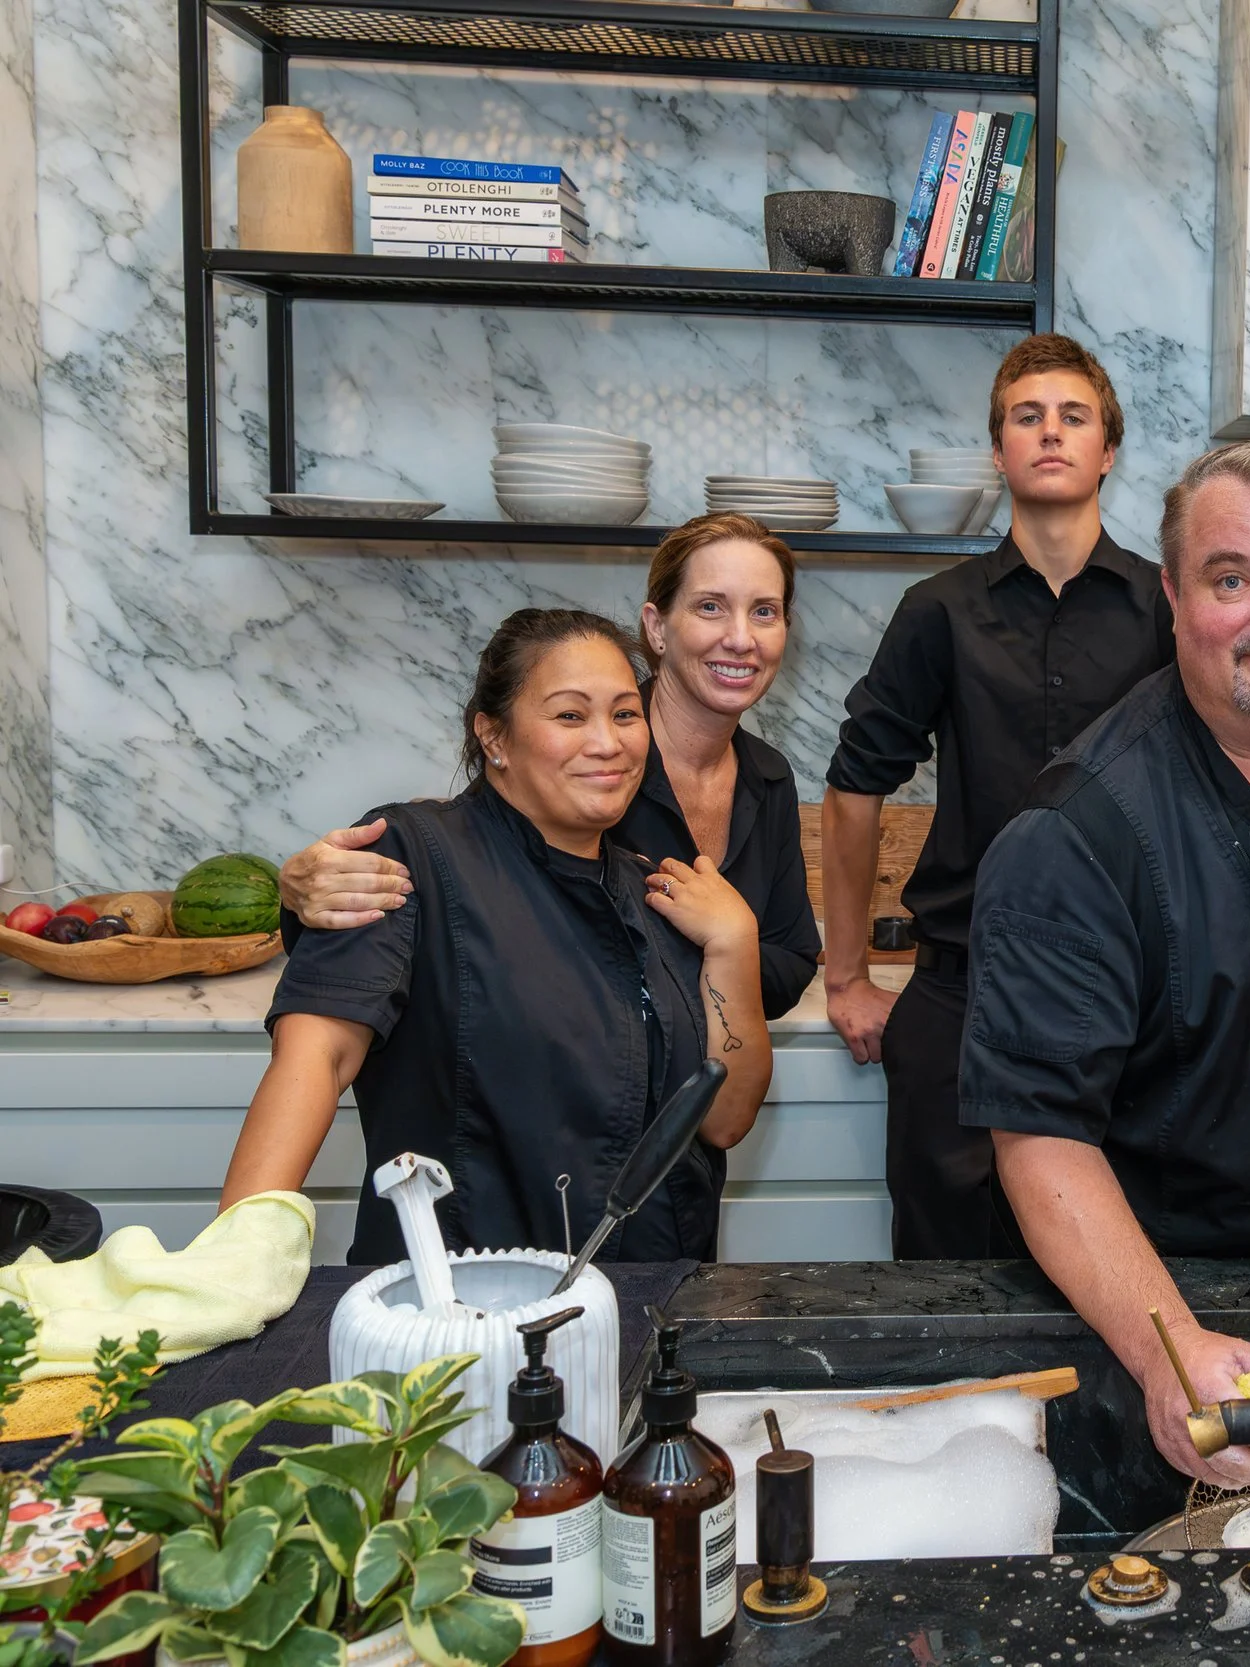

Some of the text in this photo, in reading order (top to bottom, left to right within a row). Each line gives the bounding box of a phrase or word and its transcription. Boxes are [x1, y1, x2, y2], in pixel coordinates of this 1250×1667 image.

[926, 136, 941, 167] FIRST
[944, 129, 968, 184] ASADA
[988, 126, 1008, 167] mostly
[381, 160, 407, 168] MOLLY
[441, 161, 470, 176] COOK
[475, 163, 489, 177] THIS
[494, 164, 523, 179] BOOK
[427, 182, 511, 195] OTTOLENGHI
[979, 169, 999, 206] plants
[424, 204, 520, 217] PLENTY MORE
[987, 196, 1008, 256] HEALTHFUL
[437, 224, 505, 242] SWEET
[951, 217, 964, 252] AT TIMES
